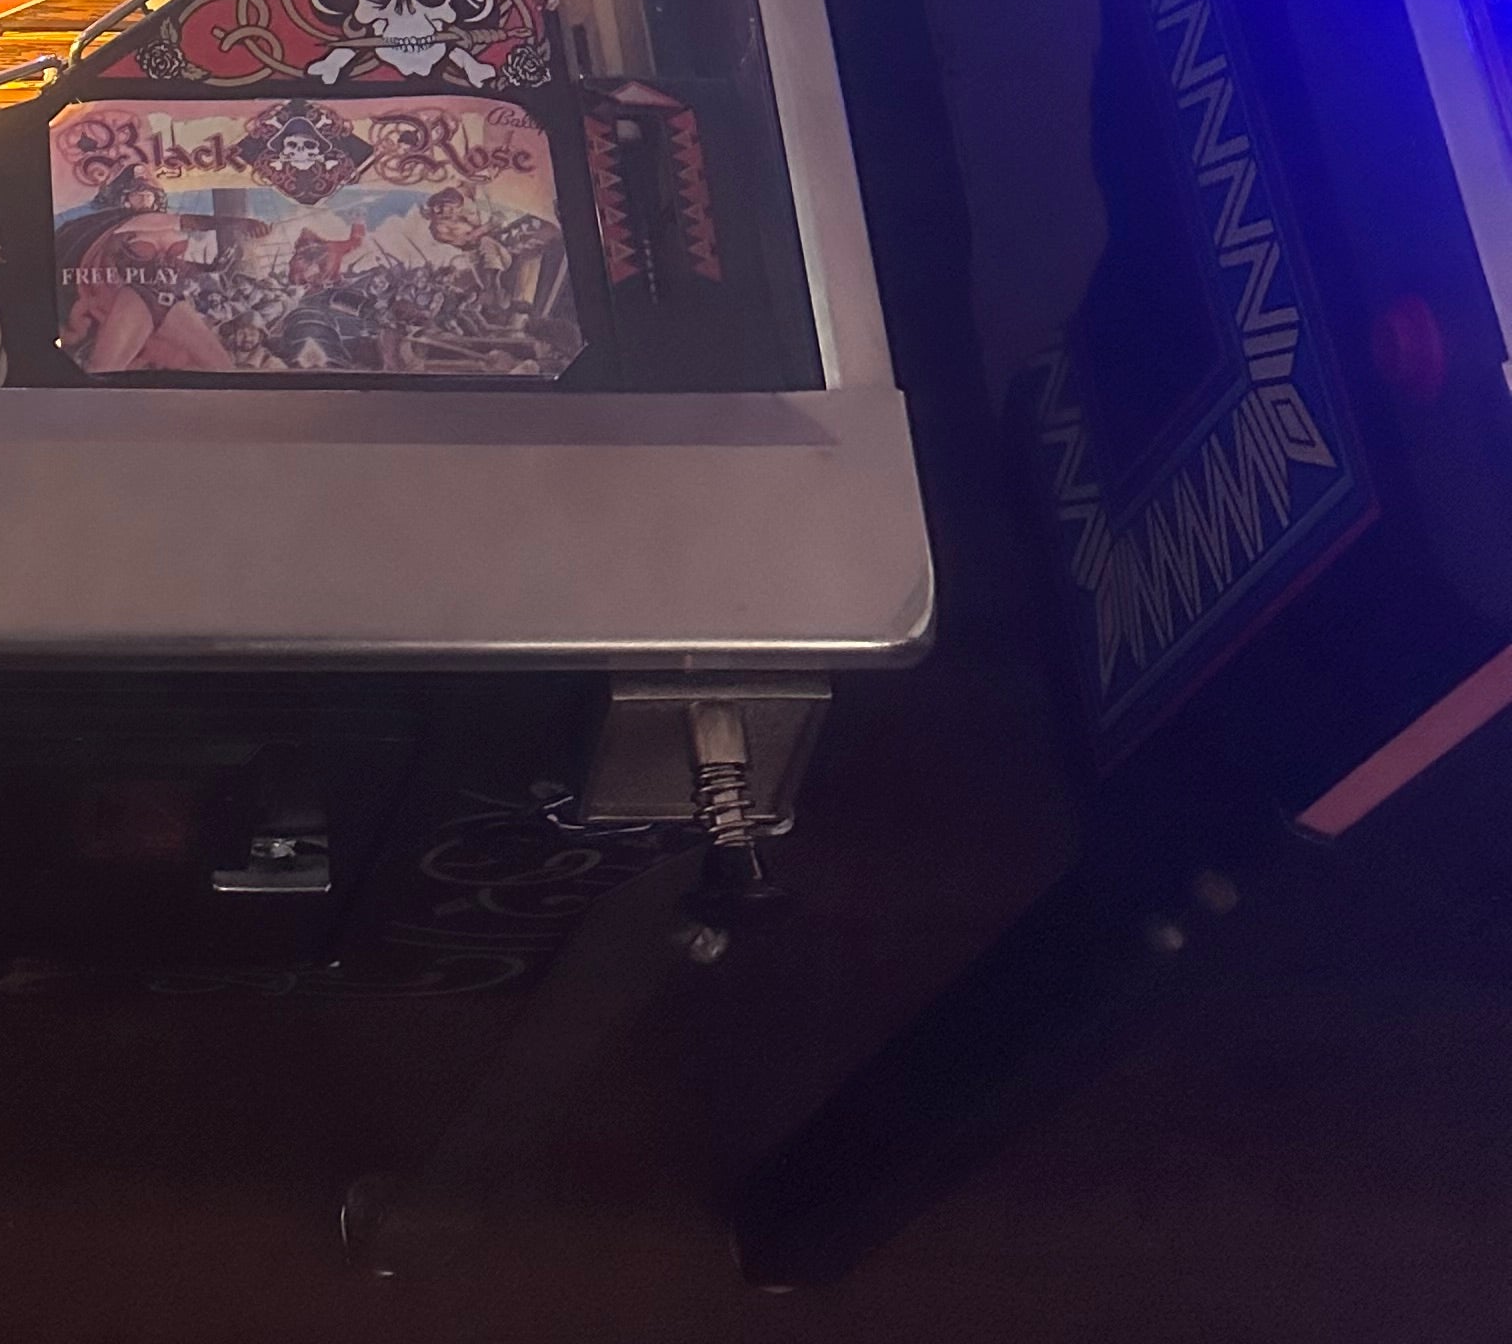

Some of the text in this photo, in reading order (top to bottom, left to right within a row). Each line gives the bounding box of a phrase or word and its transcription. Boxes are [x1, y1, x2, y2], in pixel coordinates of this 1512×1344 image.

[56, 107, 535, 188] Black Rose
[62, 267, 178, 285] FREE PLAY
